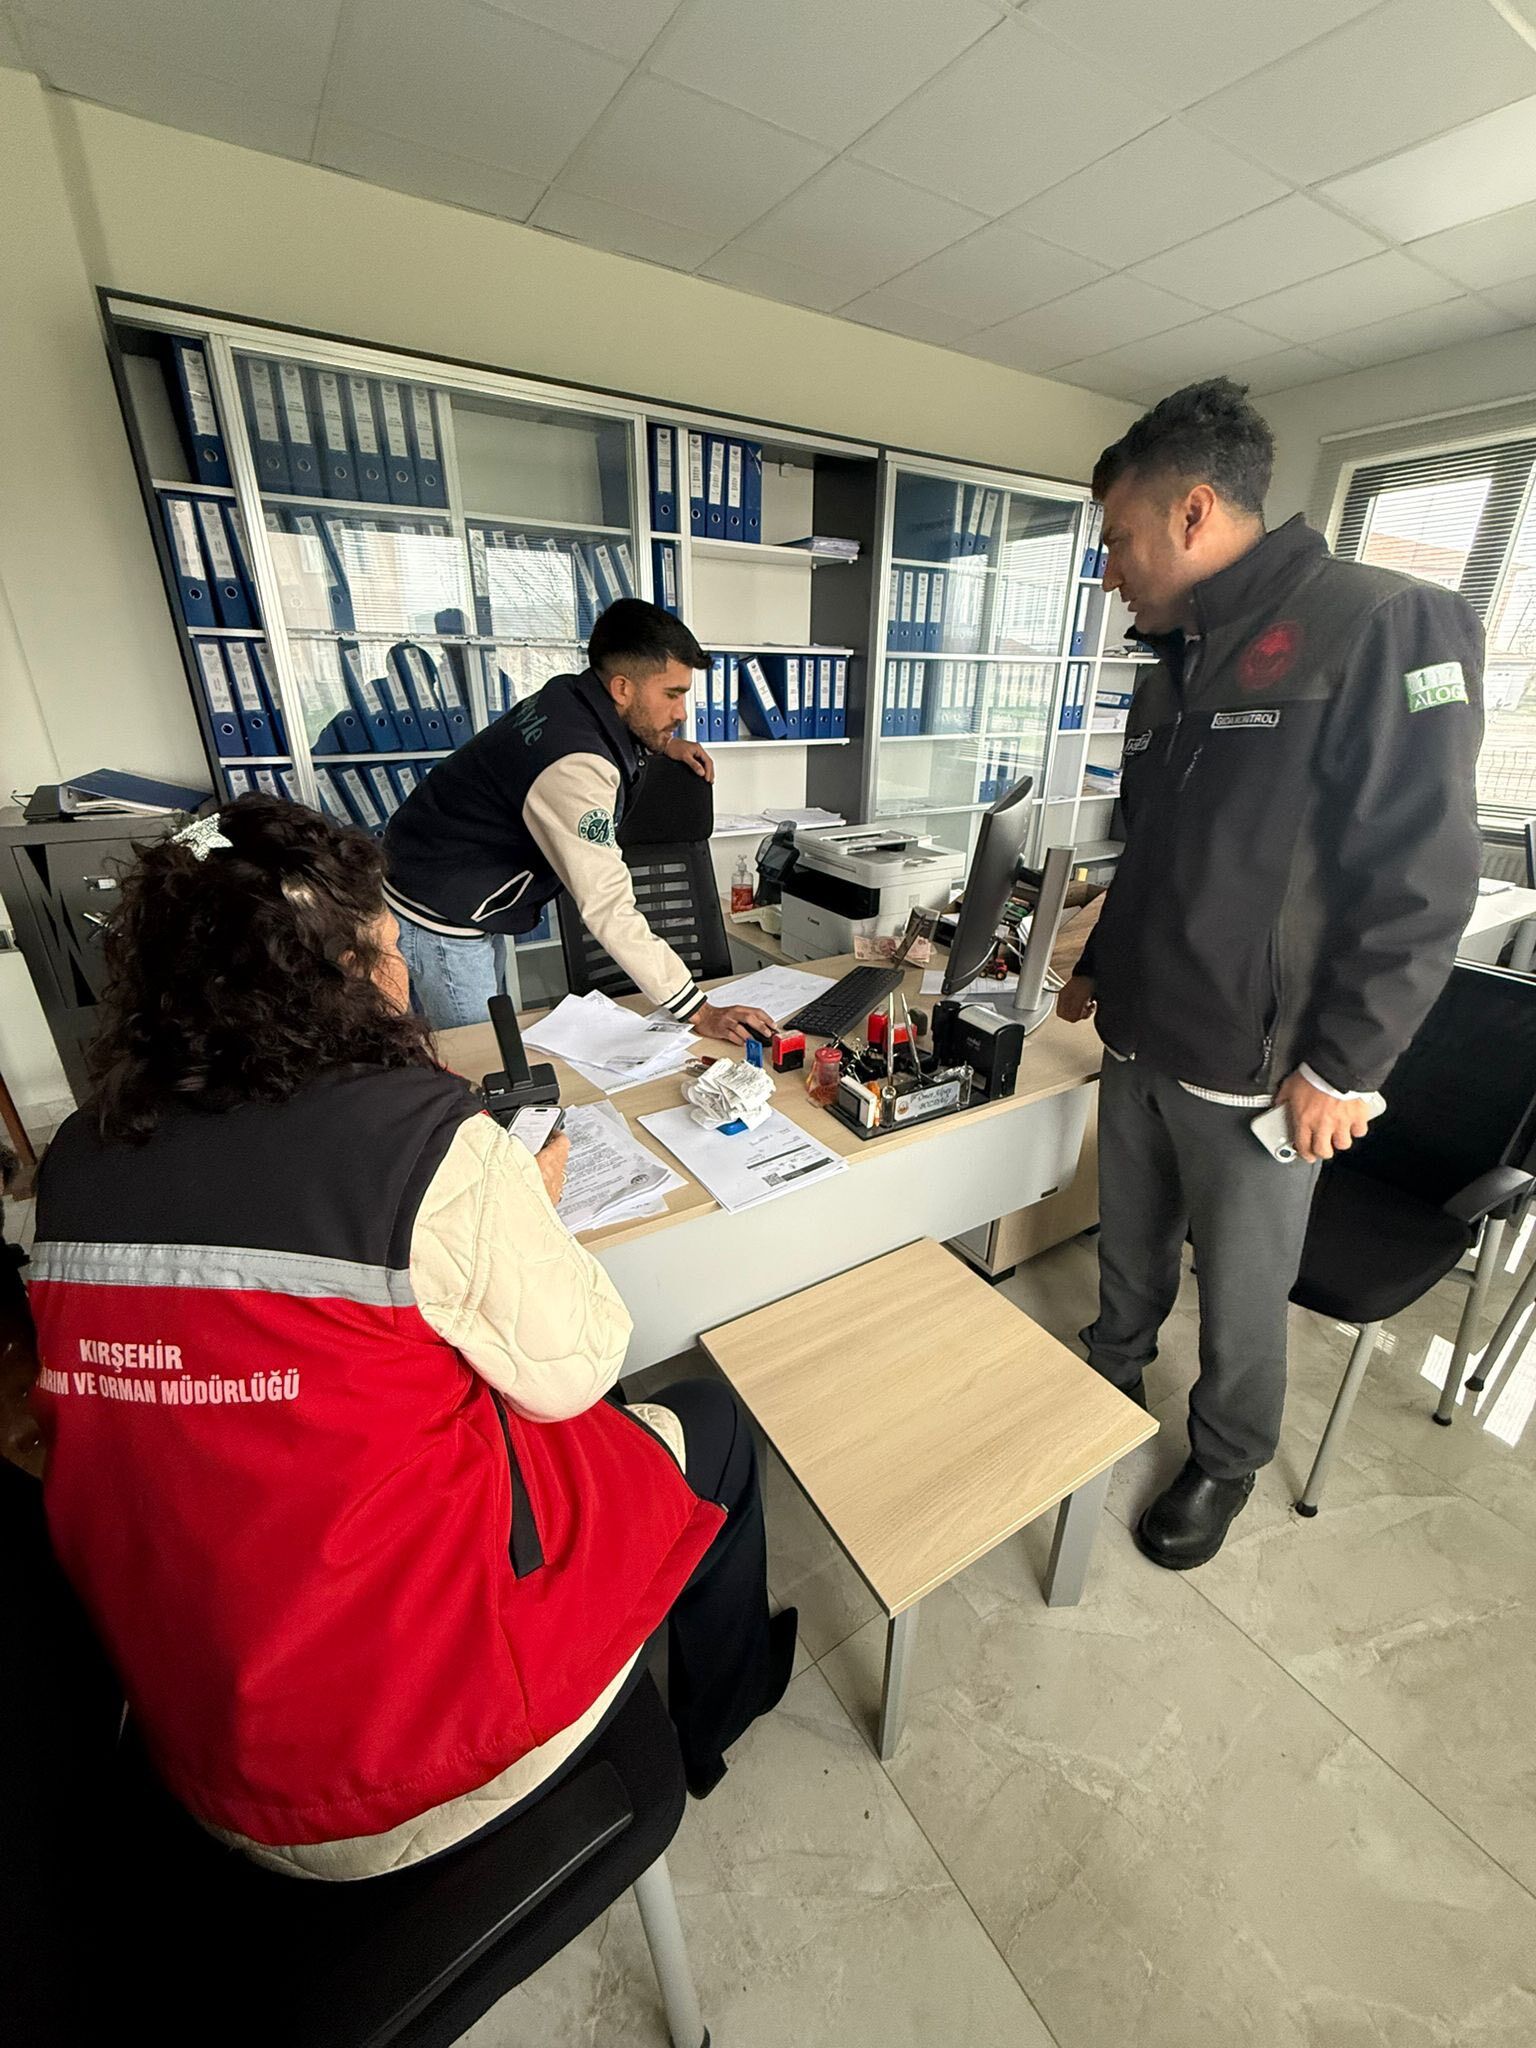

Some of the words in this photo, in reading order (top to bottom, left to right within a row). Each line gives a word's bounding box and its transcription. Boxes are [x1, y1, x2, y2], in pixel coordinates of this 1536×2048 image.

[79, 1338, 183, 1373] KIRŞEHİR
[38, 1366, 69, 1395] ARIM
[73, 1372, 97, 1395] VE
[99, 1374, 156, 1404] ORMAN
[161, 1367, 300, 1405] MÜDÜRLÜĞÜ
